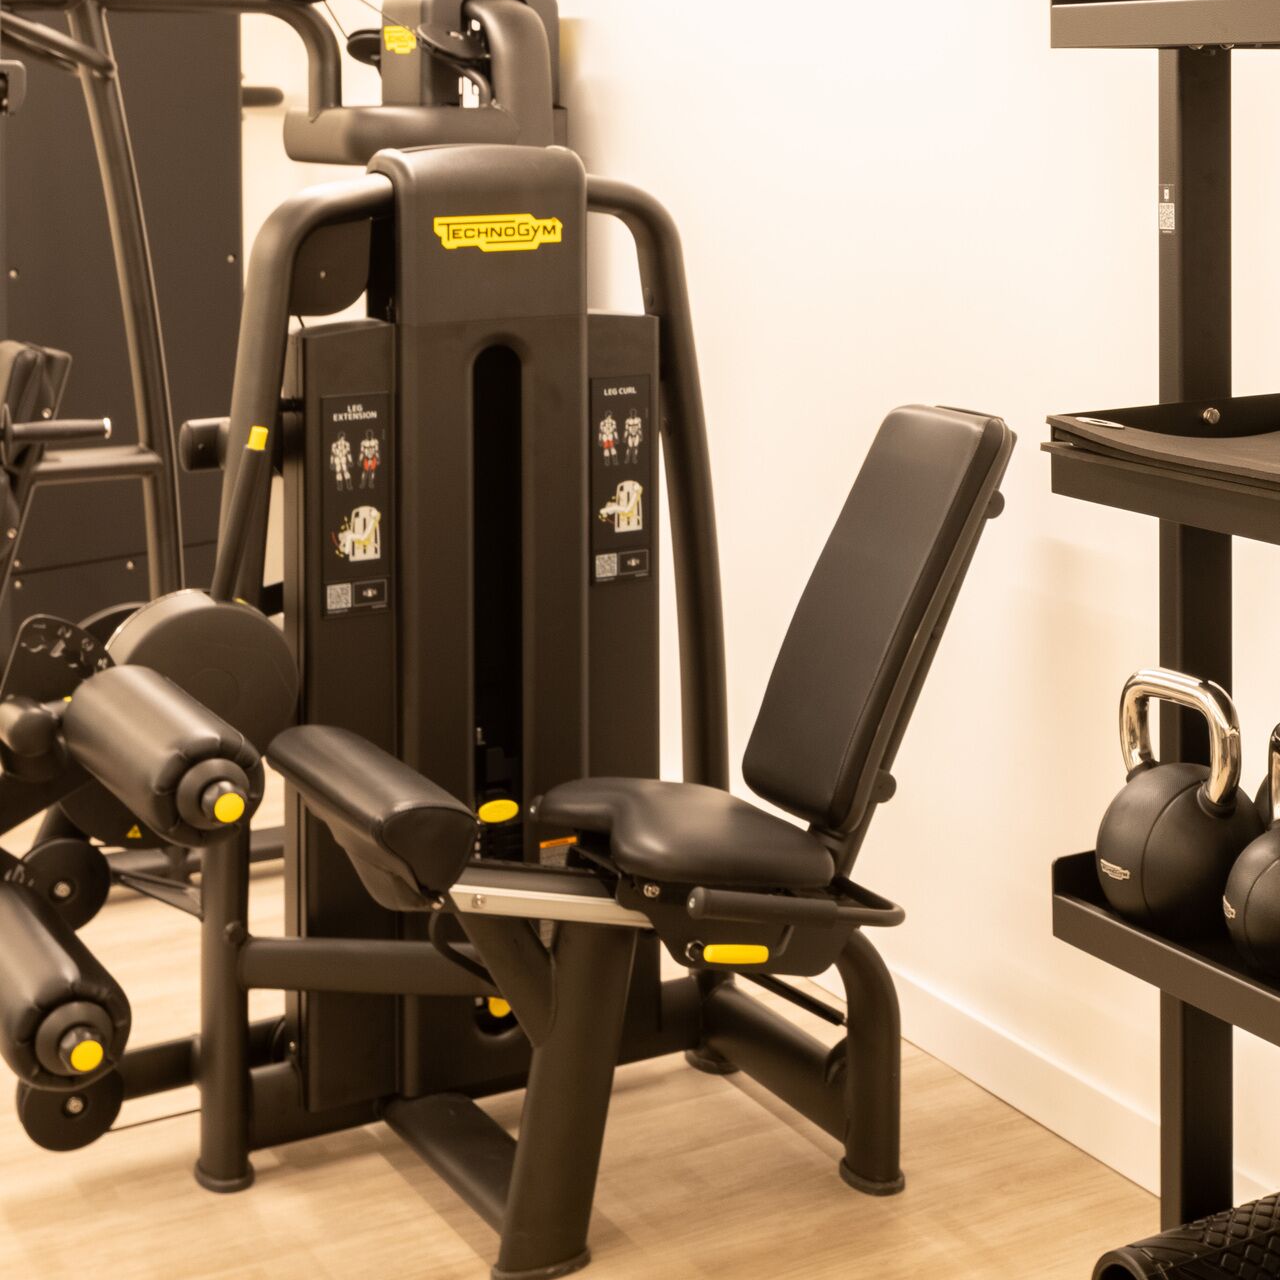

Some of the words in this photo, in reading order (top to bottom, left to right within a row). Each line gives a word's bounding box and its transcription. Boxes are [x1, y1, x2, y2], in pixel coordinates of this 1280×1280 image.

[603, 387, 618, 397] LEG
[346, 403, 363, 413] LEG
[332, 410, 378, 422] EXTENSION
